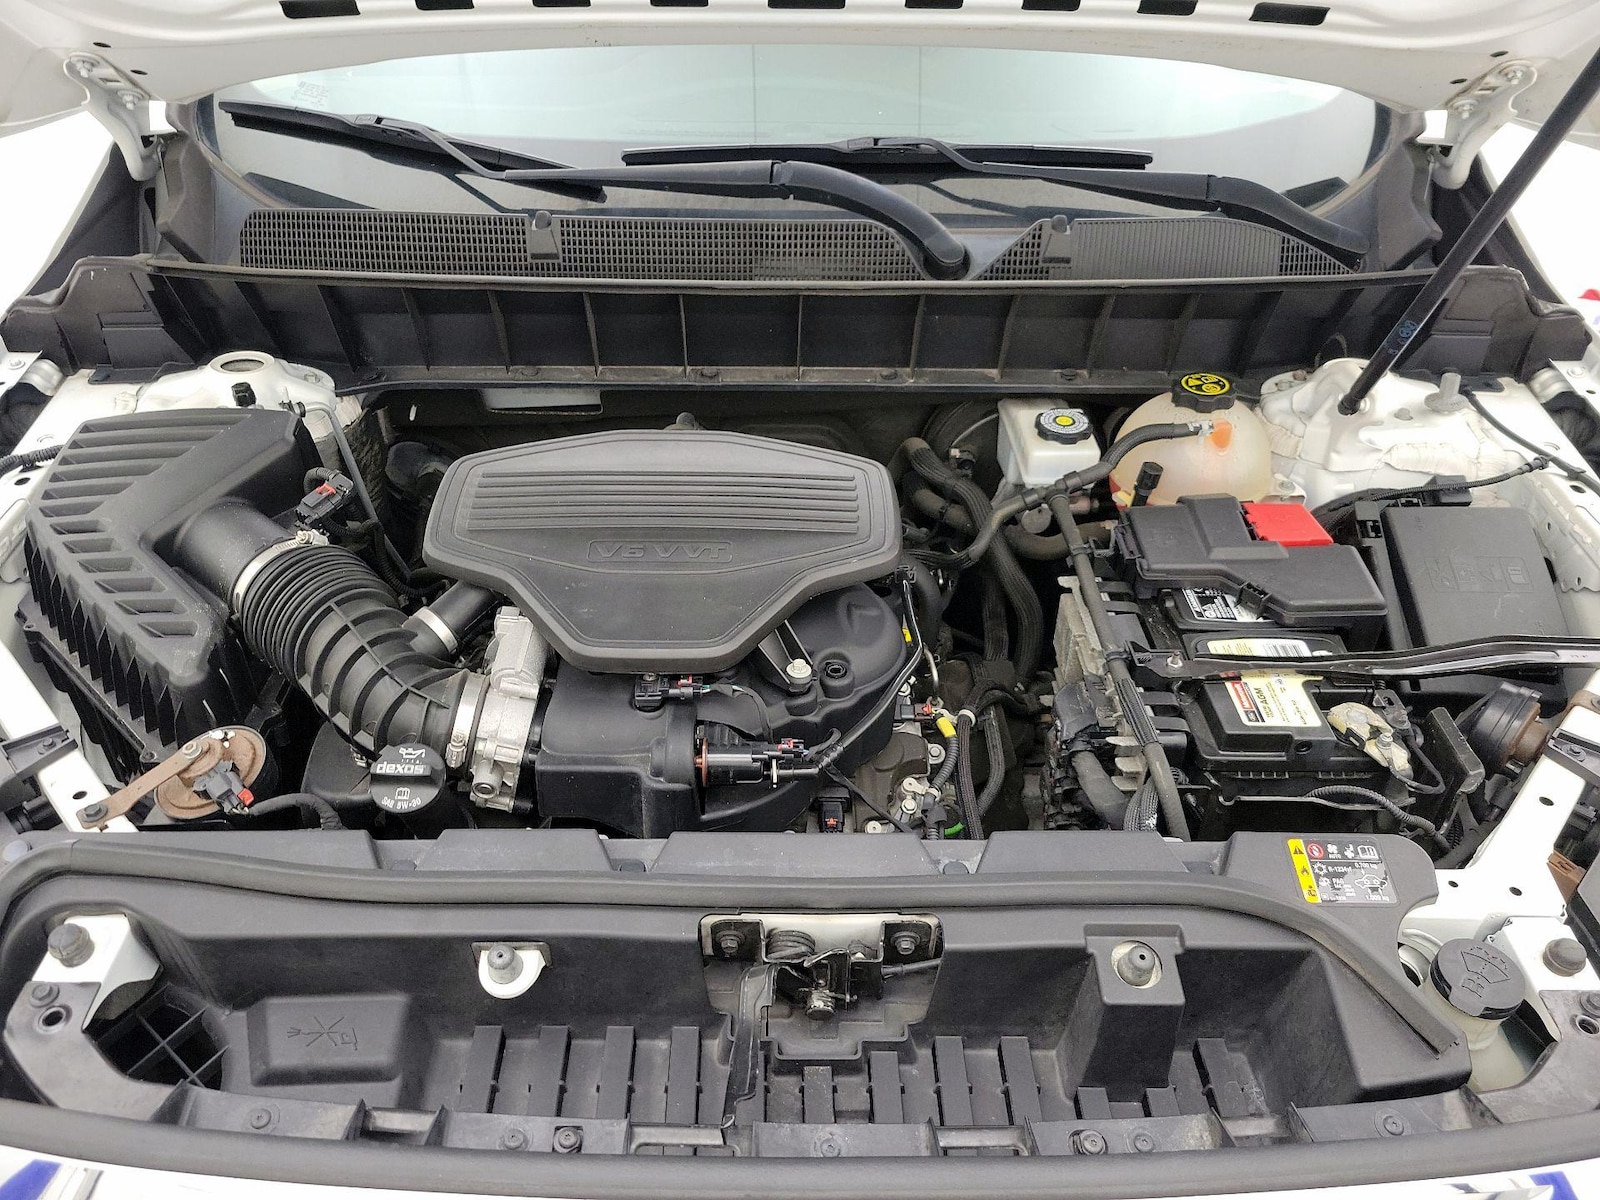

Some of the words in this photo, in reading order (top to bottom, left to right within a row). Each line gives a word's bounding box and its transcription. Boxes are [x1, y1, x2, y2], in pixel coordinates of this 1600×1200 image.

[594, 544, 646, 559] V6
[653, 544, 727, 560] VVT
[1254, 687, 1269, 705] AGM
[376, 761, 425, 775] dexos
